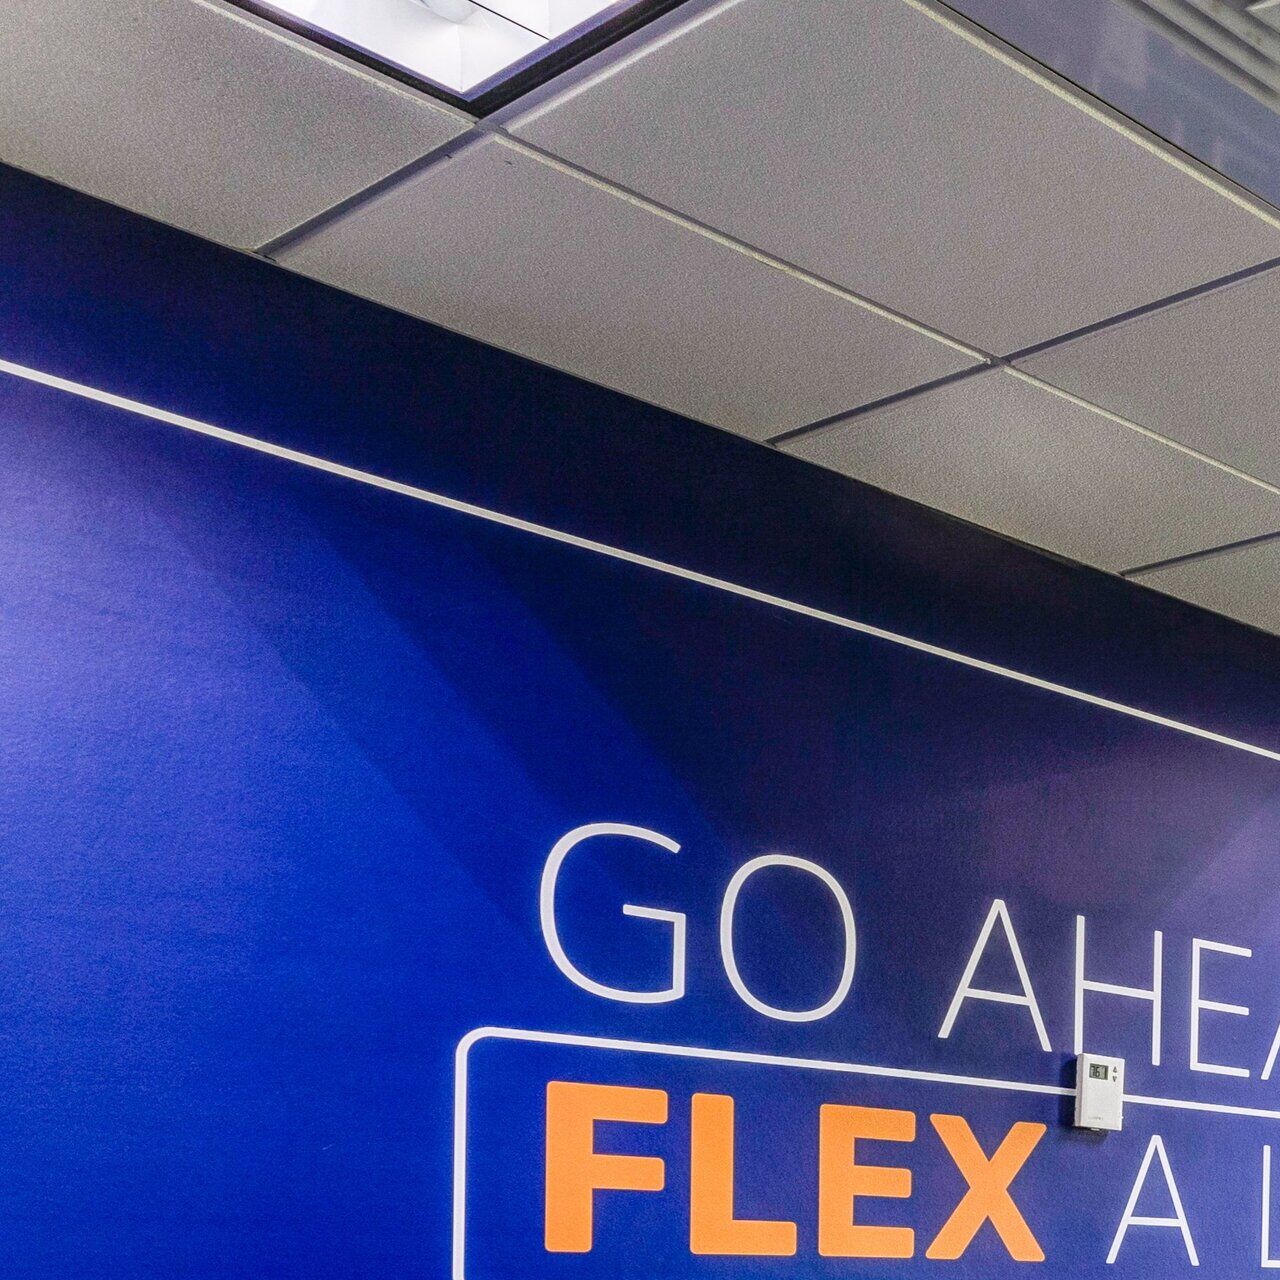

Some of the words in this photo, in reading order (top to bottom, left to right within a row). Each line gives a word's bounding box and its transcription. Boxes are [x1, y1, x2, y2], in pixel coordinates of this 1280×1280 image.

[539, 822, 857, 1023] GO
[545, 1081, 1047, 1262] FLEX
[1105, 1134, 1200, 1267] A
